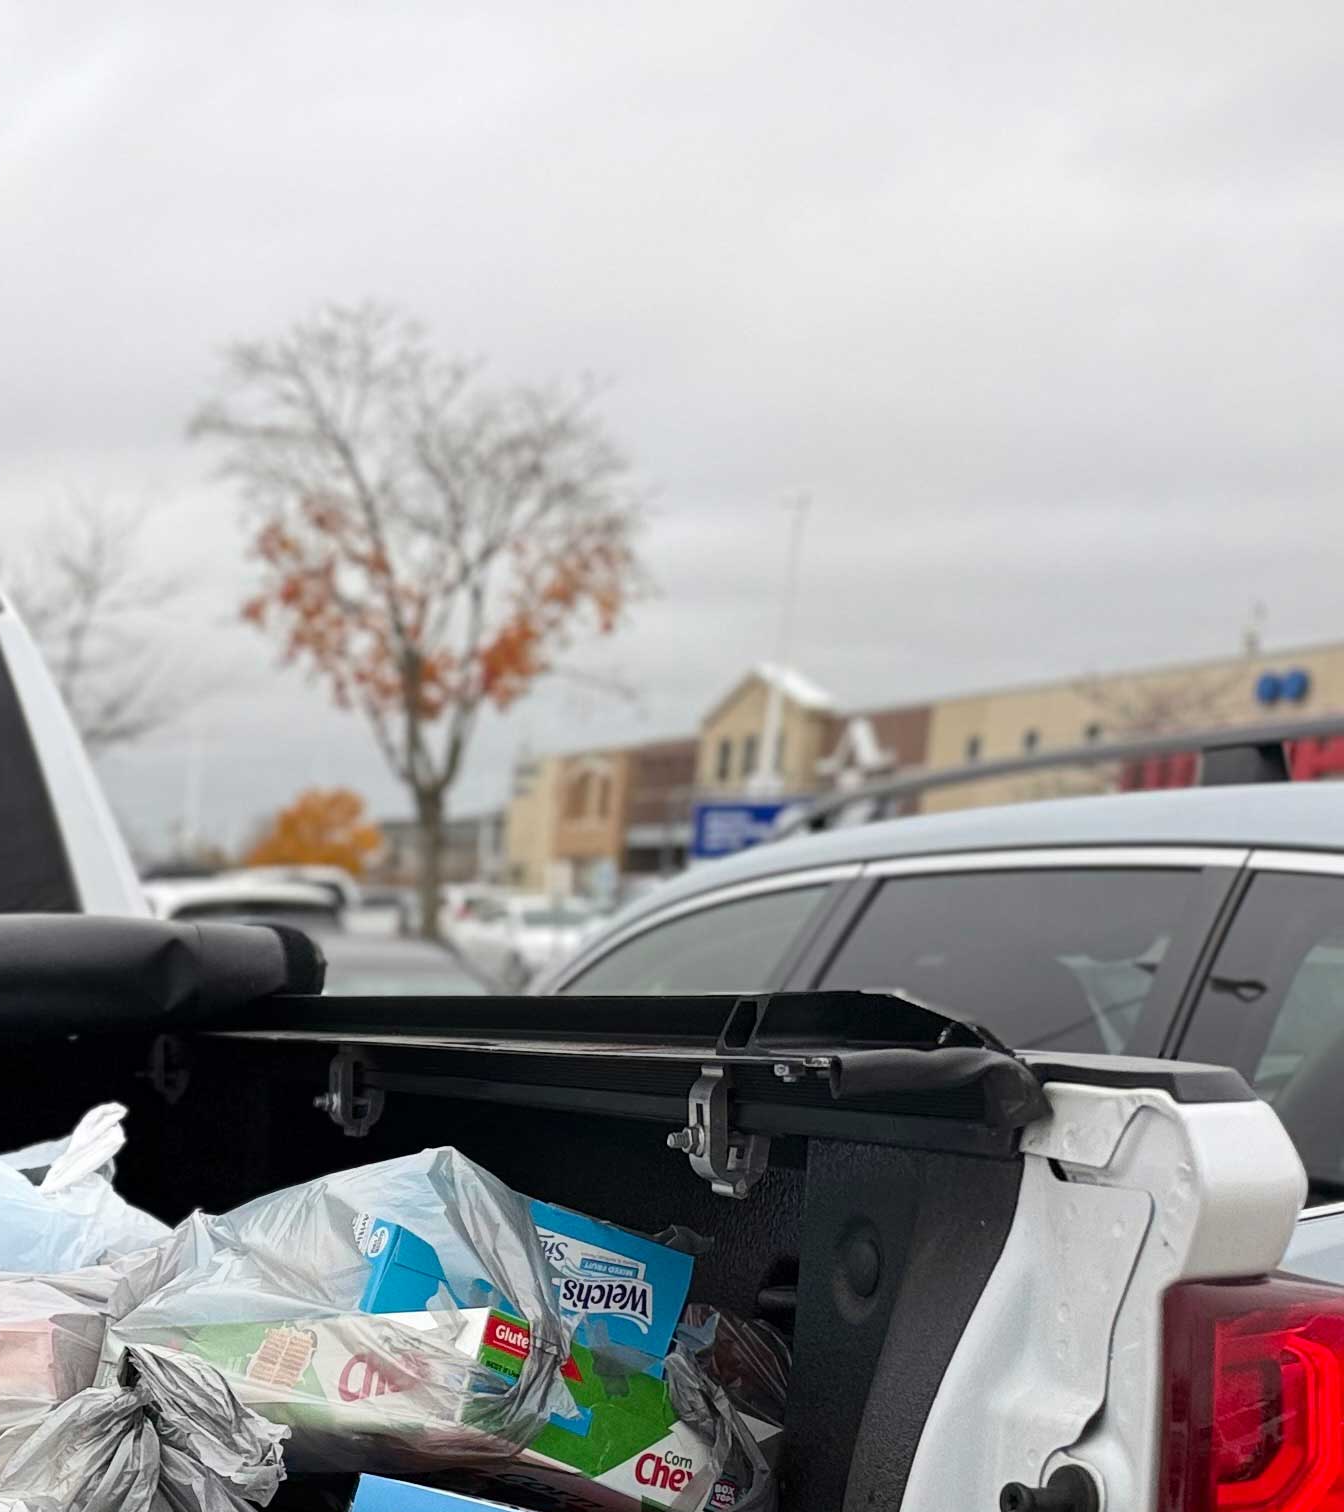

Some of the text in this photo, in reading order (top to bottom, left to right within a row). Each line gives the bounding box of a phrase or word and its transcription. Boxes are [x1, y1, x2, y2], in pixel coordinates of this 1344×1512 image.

[562, 1279, 649, 1318] Welch's
[495, 1324, 531, 1349] Glute
[664, 1451, 692, 1469] Corn
